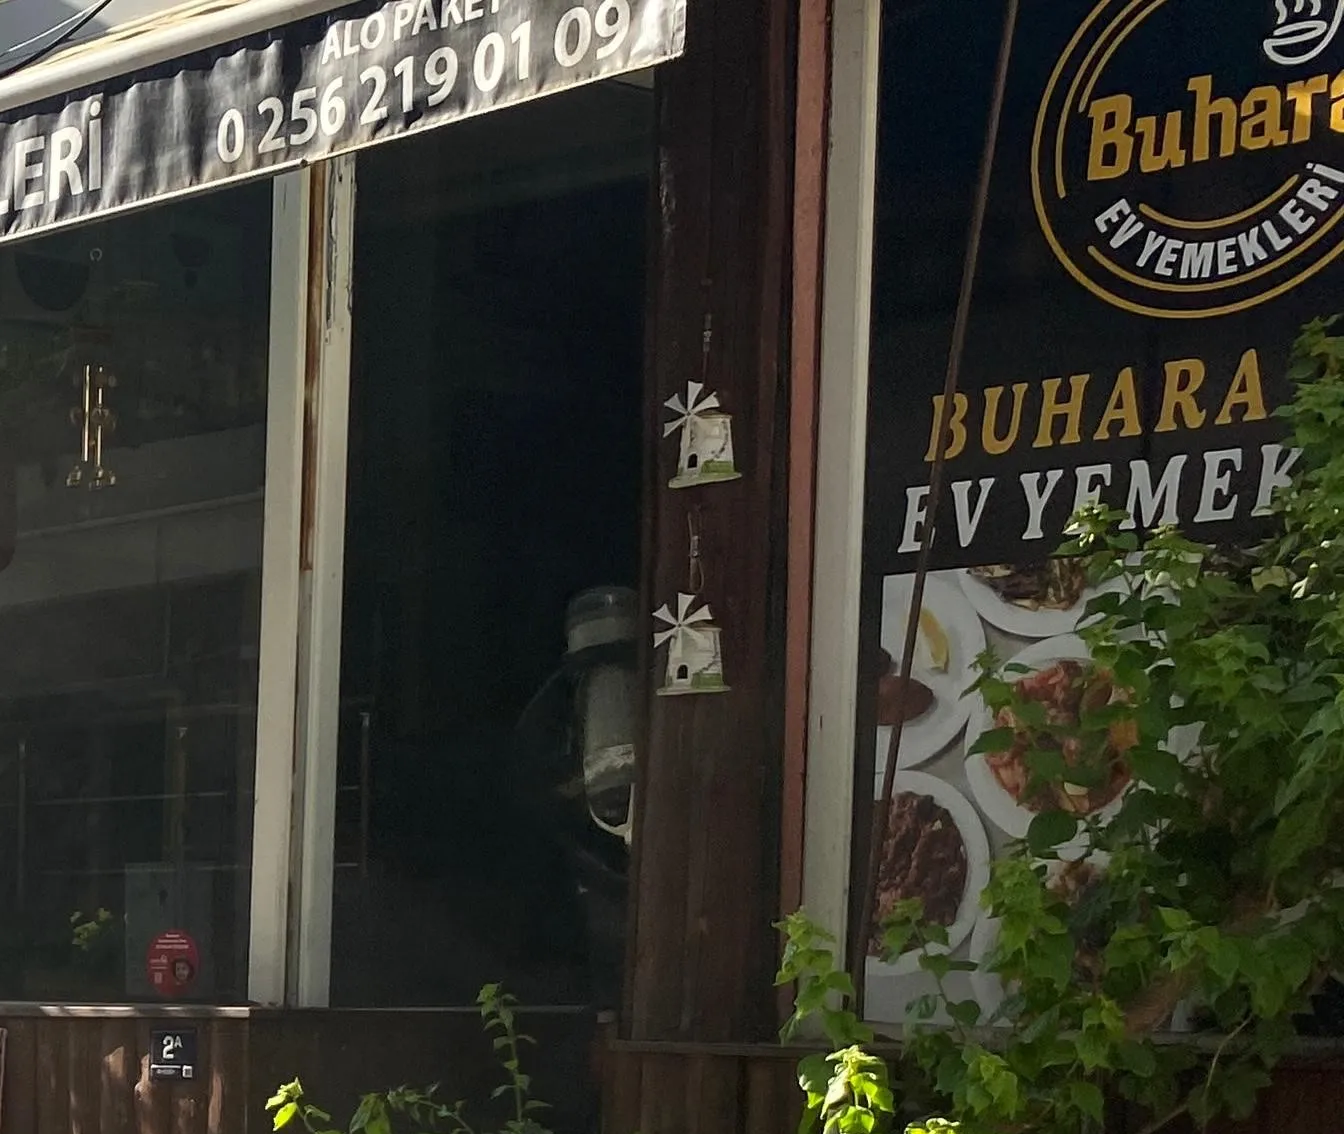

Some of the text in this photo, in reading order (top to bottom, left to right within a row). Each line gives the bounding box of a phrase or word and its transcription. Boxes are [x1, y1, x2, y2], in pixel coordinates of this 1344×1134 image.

[216, 0, 631, 164] 0 256 219 01 09
[320, 12, 387, 65] ALO
[1094, 162, 1344, 279] EV YEMEKLERİ
[923, 347, 1269, 464] BUHARA
[897, 477, 997, 555] EV
